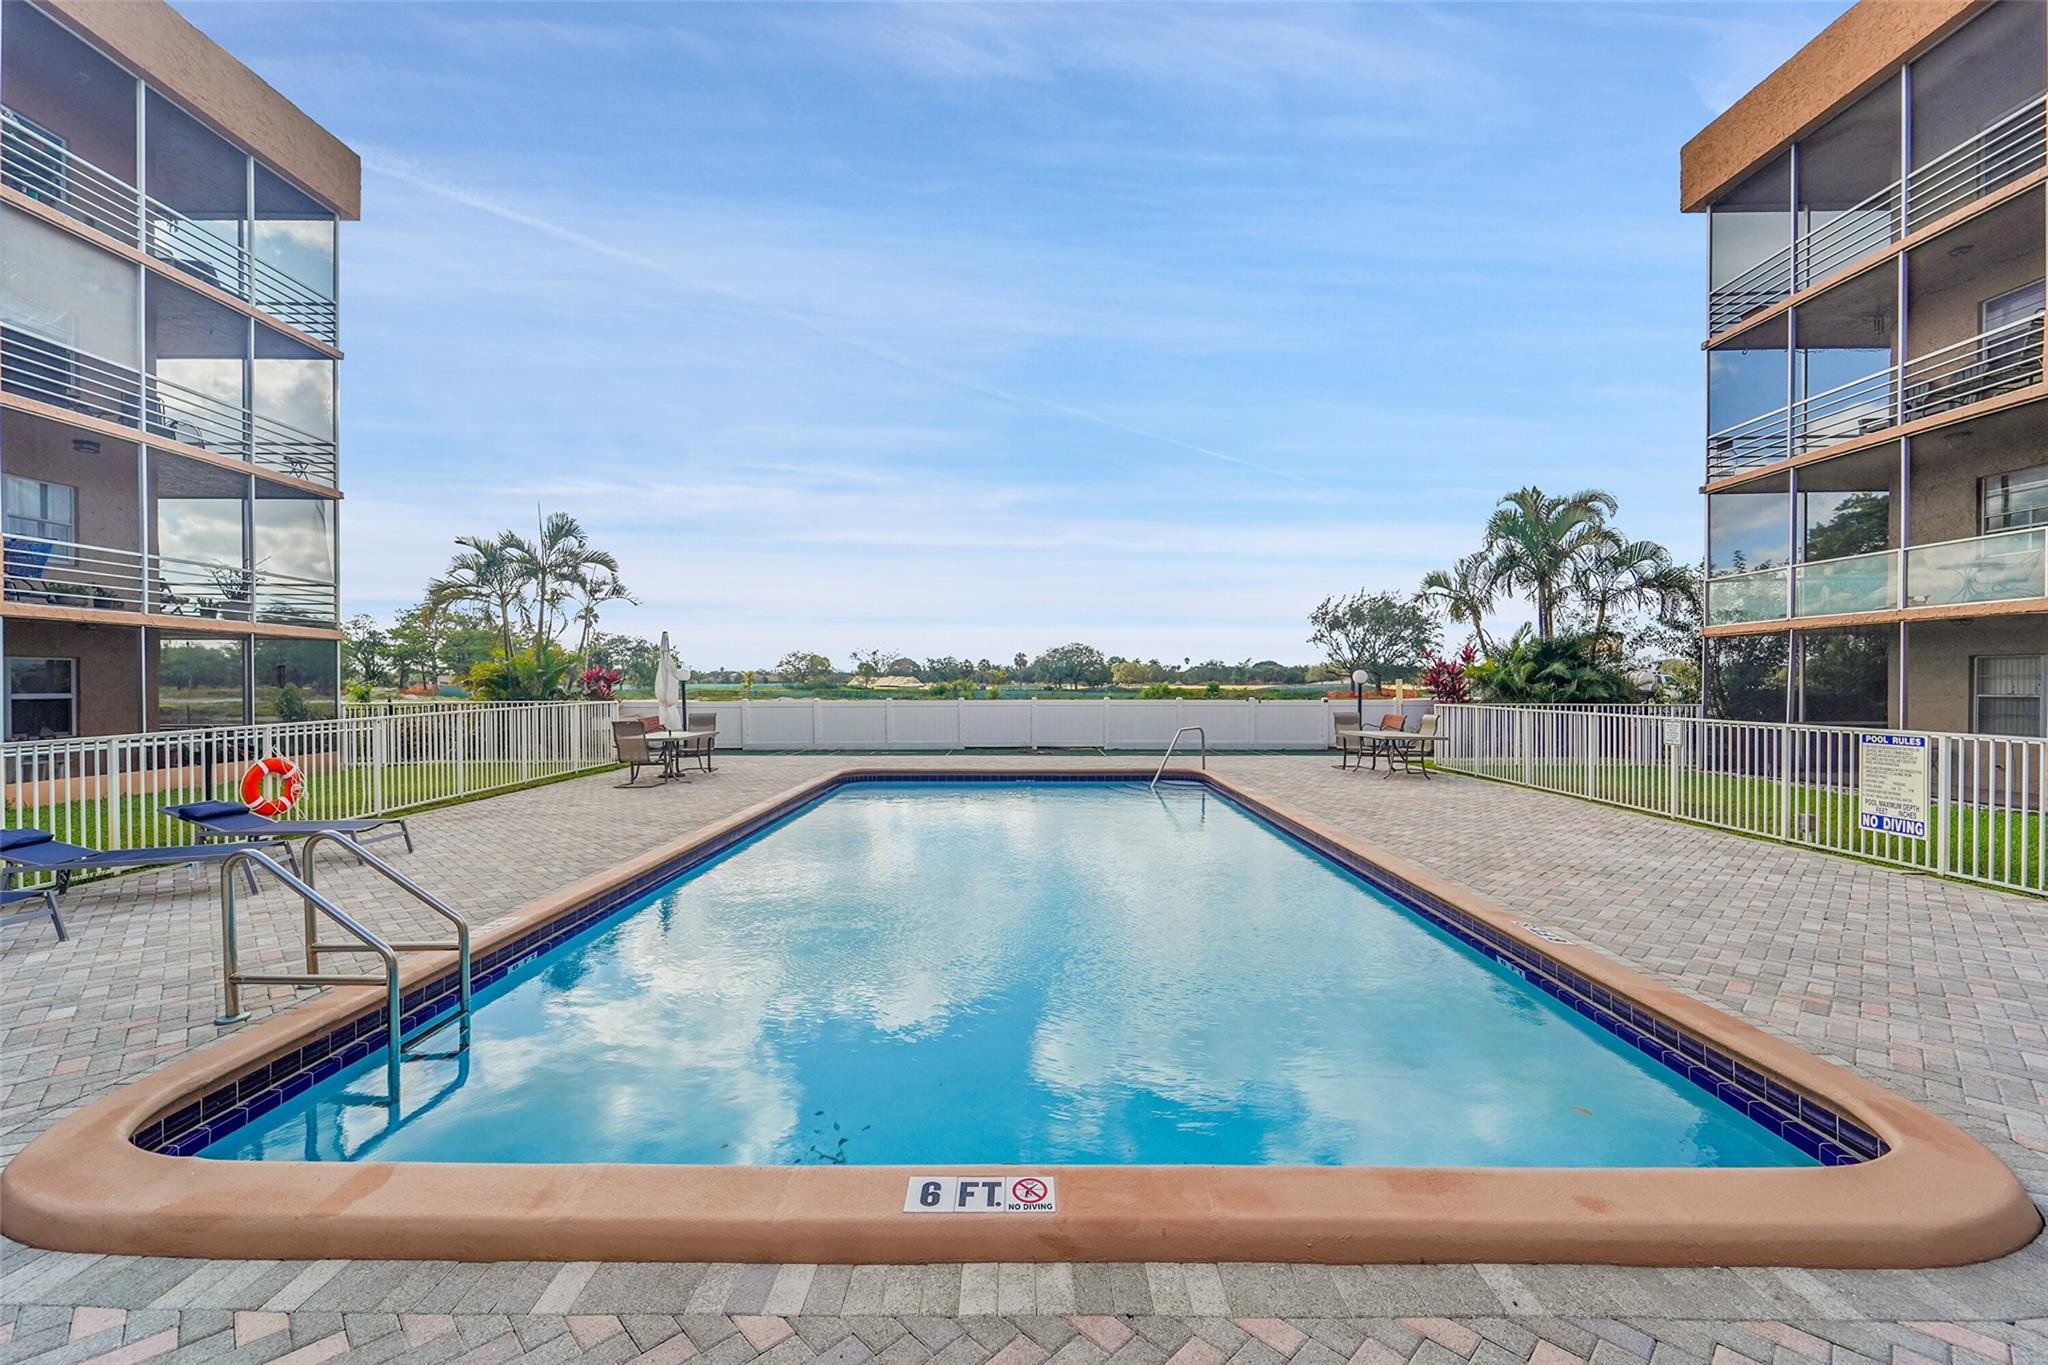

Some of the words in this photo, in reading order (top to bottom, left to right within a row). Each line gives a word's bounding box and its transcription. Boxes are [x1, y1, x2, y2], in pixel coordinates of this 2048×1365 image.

[1866, 735, 1888, 744] POOL
[1892, 736, 1921, 746] RULES
[1865, 798, 1879, 807] POOL
[1878, 800, 1902, 810] MAXIMUM
[1902, 803, 1920, 812] DEPTH
[1876, 807, 1888, 815] FEET
[1898, 809, 1917, 819] INCHES
[1862, 814, 1879, 828] NO
[1883, 817, 1924, 836] DIVING
[919, 1181, 942, 1207] 6
[958, 1181, 1002, 1207] FT.
